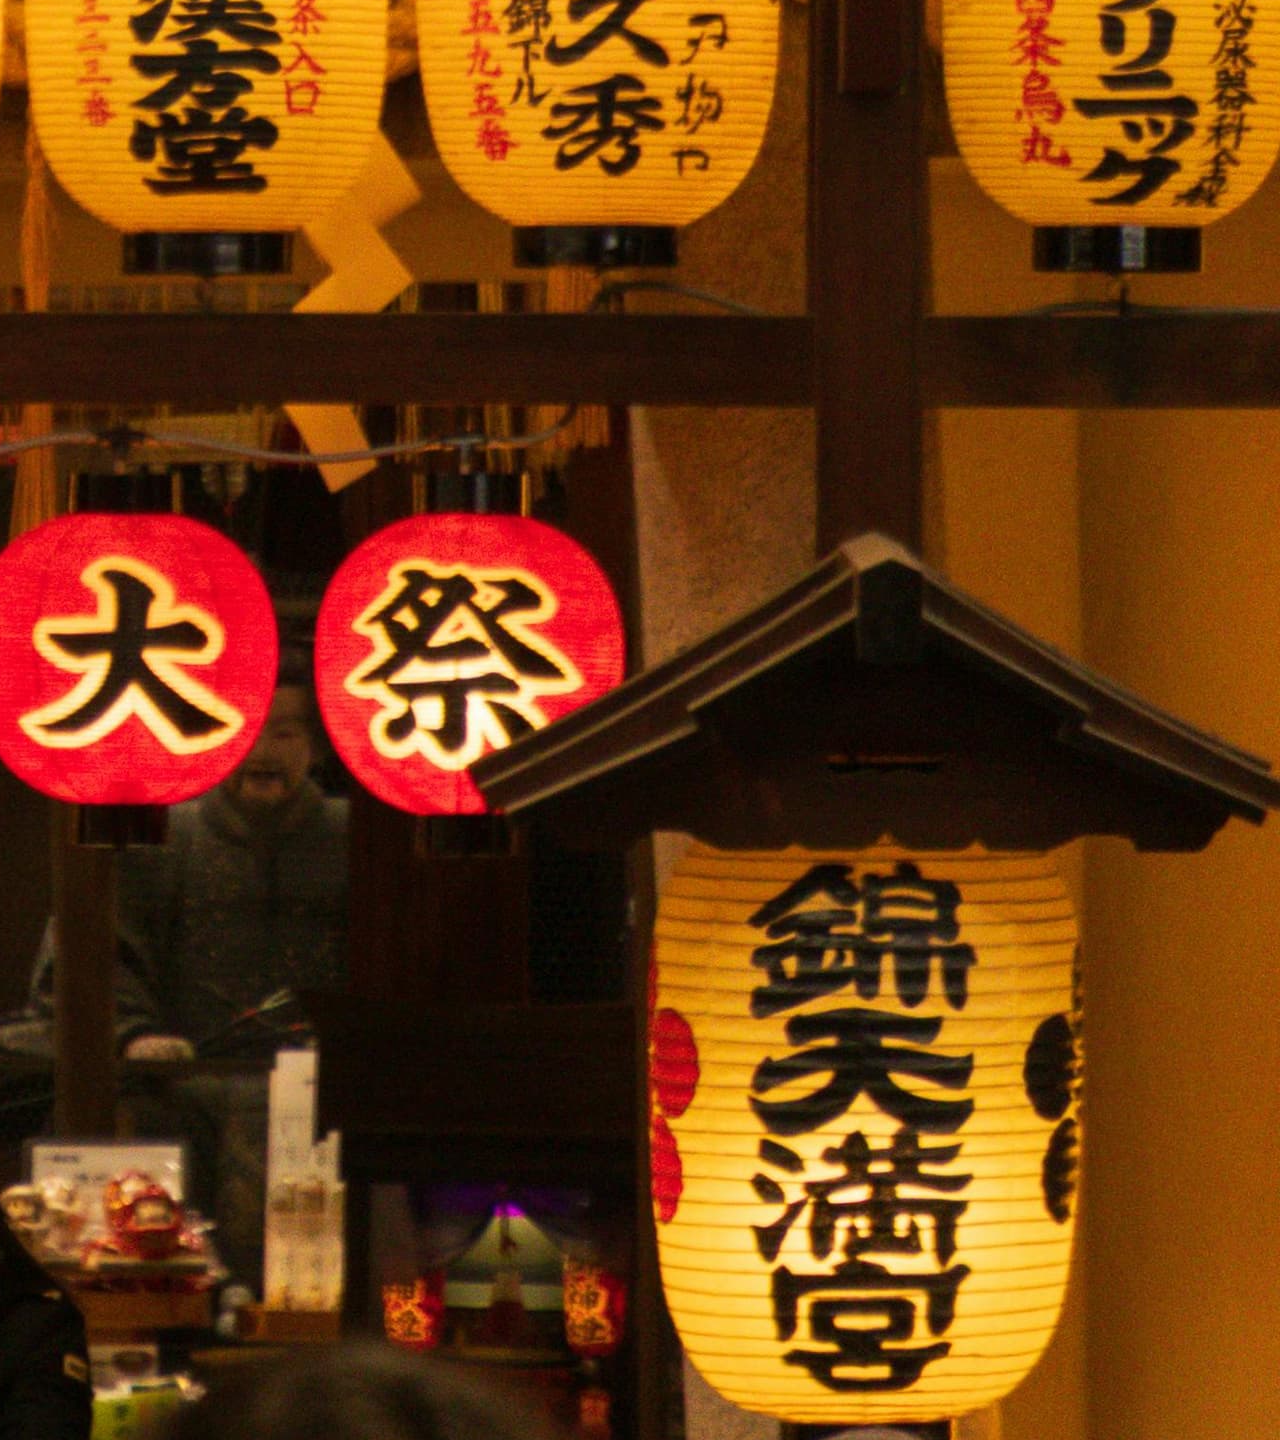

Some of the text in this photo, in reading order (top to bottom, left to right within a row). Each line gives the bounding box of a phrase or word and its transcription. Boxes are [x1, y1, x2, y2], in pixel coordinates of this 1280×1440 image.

[26, 564, 238, 746] 大
[351, 568, 574, 762] 祭
[748, 862, 975, 1393] 錦天満宮
